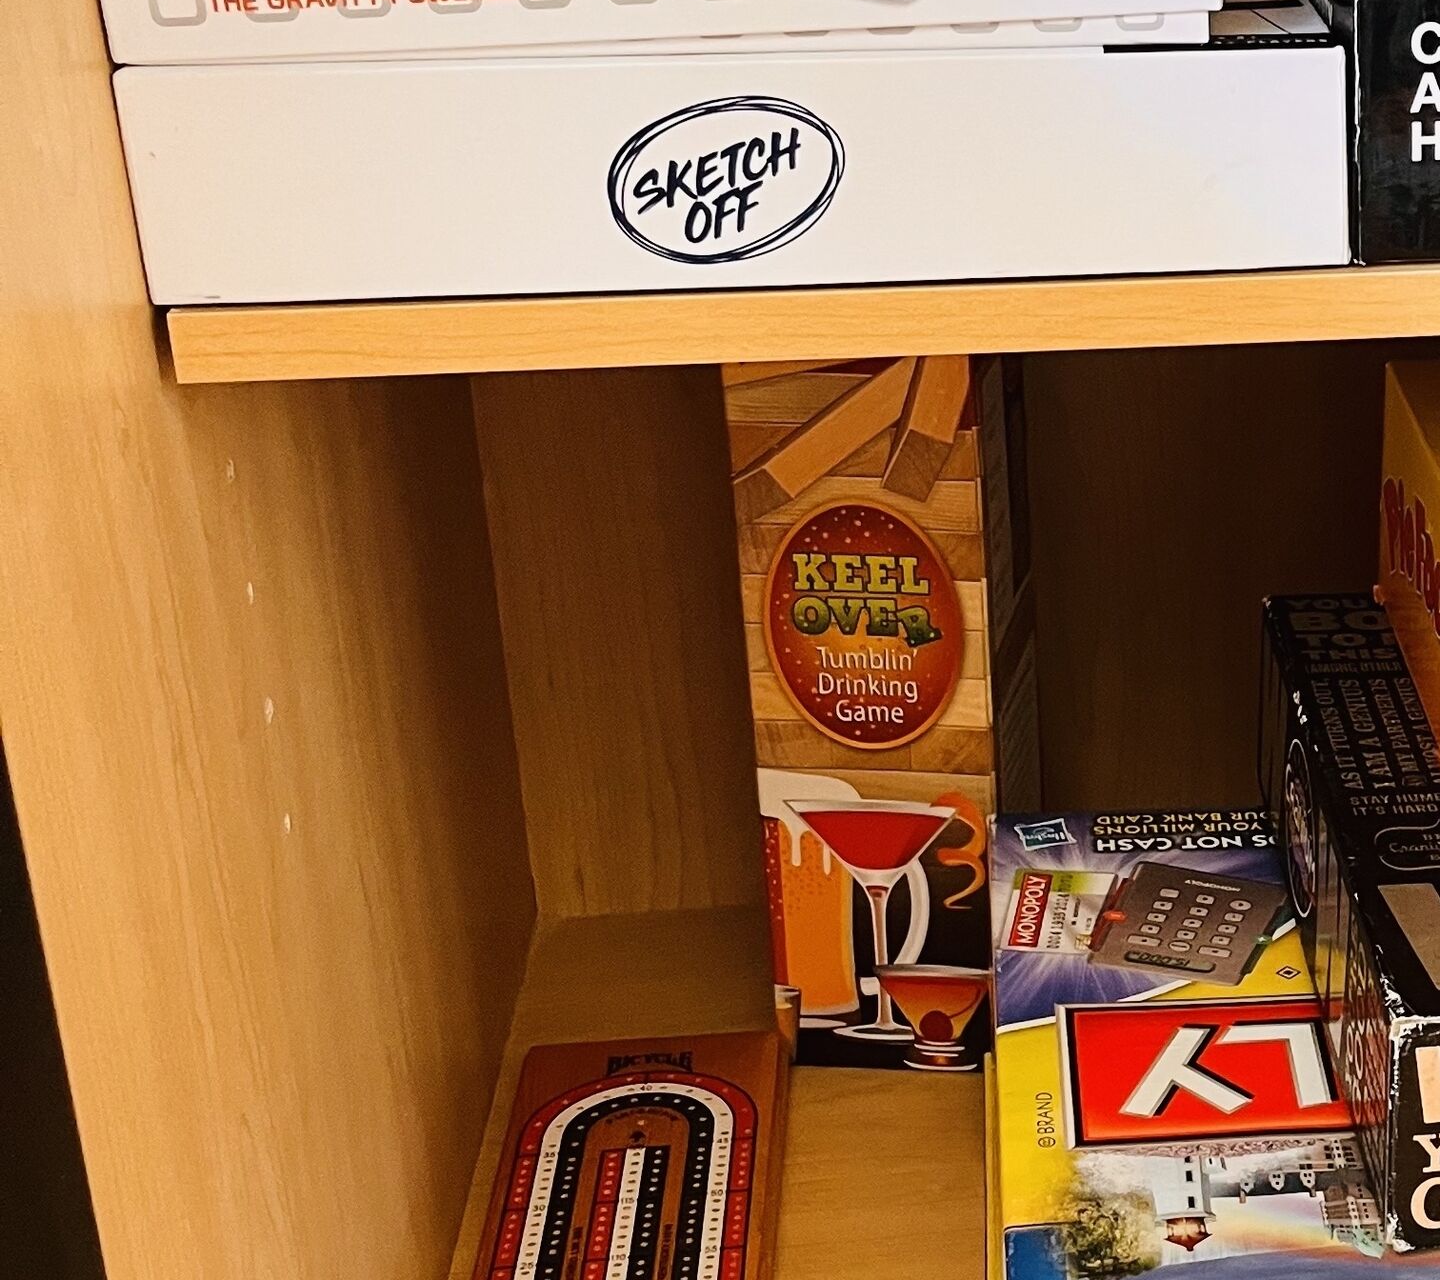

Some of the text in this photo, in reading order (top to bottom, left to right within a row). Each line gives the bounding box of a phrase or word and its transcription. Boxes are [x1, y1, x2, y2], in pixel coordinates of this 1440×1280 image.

[633, 127, 801, 215] SKETCH
[684, 180, 763, 243] OFF
[792, 553, 930, 595] KEEL
[790, 596, 942, 648] OVER
[815, 646, 918, 671] Tumblin'
[818, 673, 919, 704] Drinking
[835, 697, 905, 725] Game
[1094, 821, 1262, 836] YOUR MILLIONS
[1096, 814, 1153, 825] CARD
[1164, 813, 1222, 822] BANK
[1096, 837, 1173, 852] CASH
[1181, 835, 1243, 850] NOT
[1015, 874, 1047, 943] MONOPOLY
[1037, 1091, 1053, 1135] BRAND
